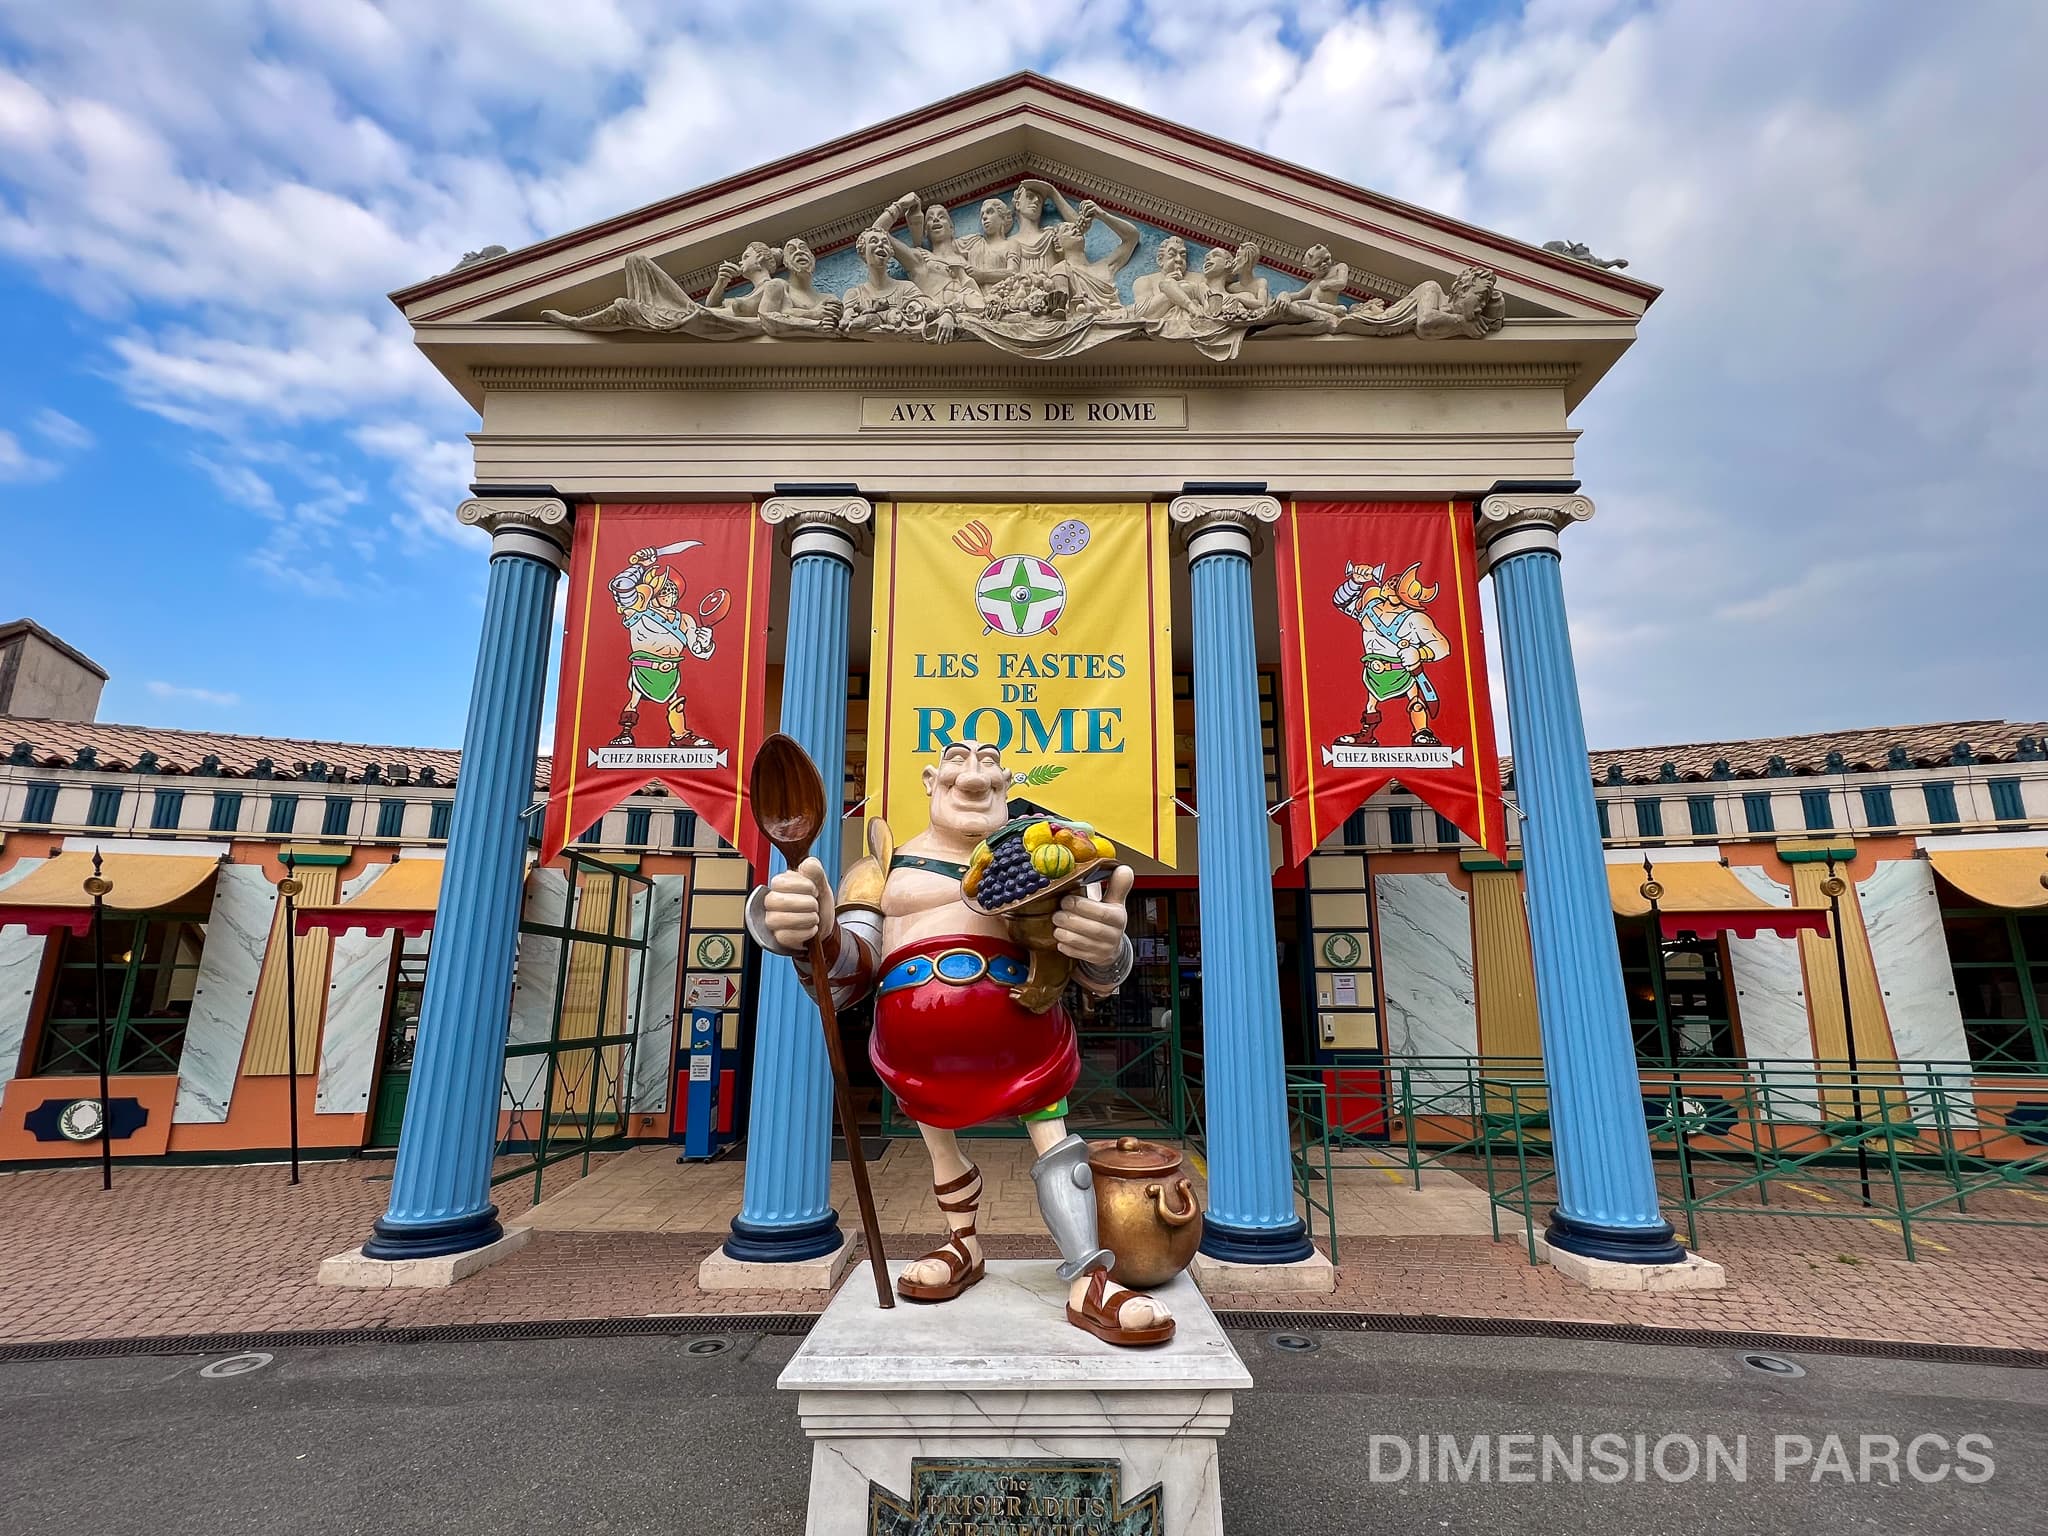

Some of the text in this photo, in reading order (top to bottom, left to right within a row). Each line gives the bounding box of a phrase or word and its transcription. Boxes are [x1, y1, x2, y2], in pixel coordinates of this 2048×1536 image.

[889, 403, 1157, 421] AVX FASTES DE ROME
[913, 653, 1126, 679] LES FASTES
[1001, 683, 1038, 703] DE
[911, 707, 1125, 754] ROME
[601, 753, 714, 764] CHEZ BRISERADIUS
[1336, 752, 1449, 763] CHEZ BRISERADIUS
[996, 1475, 1034, 1491] Chez
[926, 1495, 1106, 1518] BRISERADIUS
